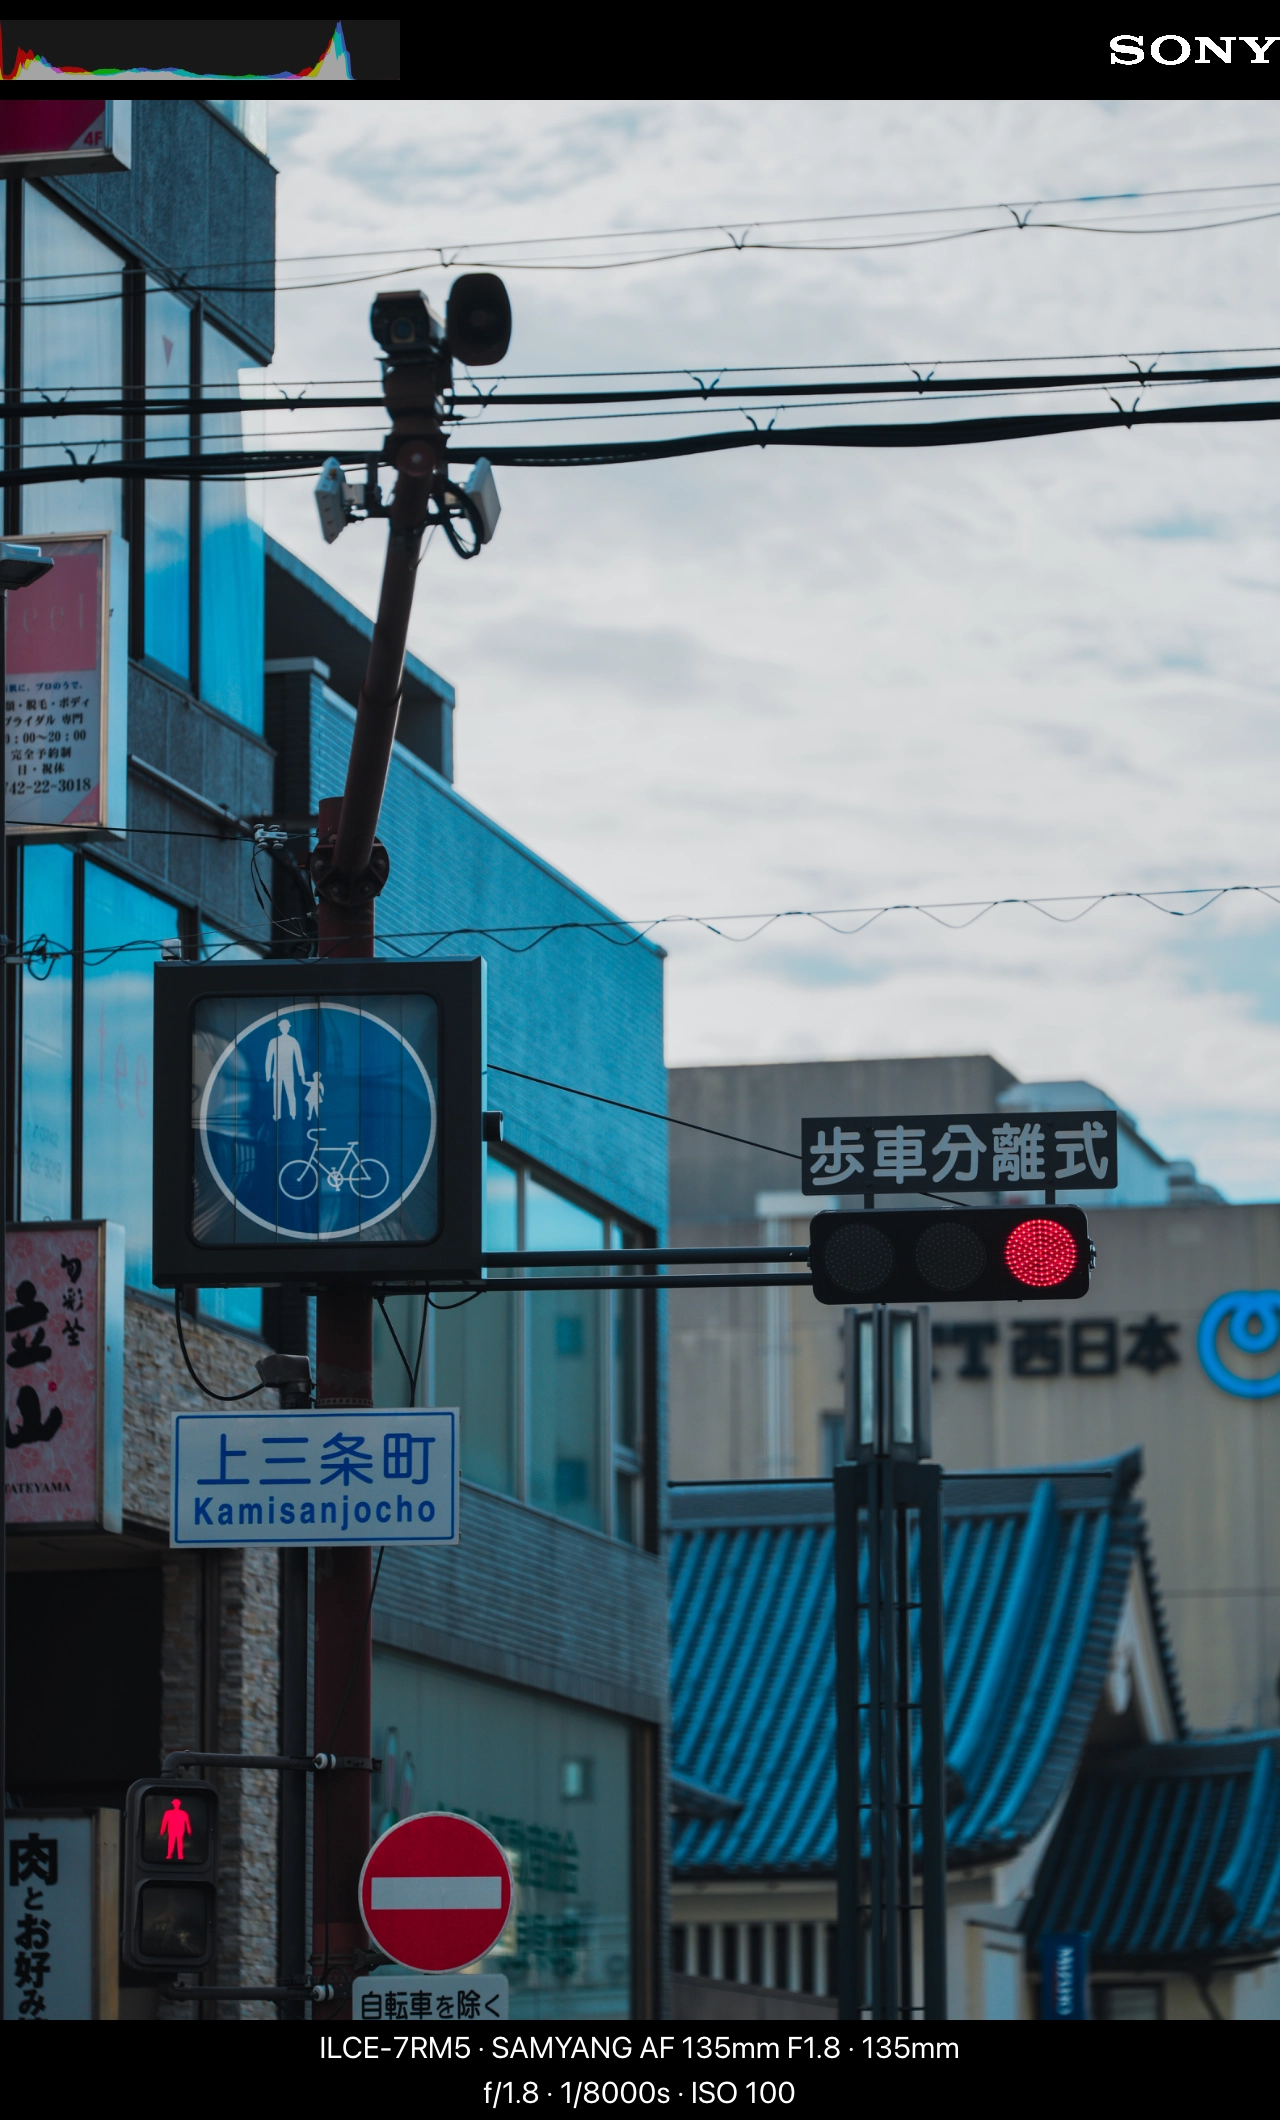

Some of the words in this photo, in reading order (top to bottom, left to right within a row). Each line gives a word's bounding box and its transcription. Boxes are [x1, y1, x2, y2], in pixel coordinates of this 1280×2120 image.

[83, 130, 103, 148] 4F
[8, 592, 86, 634] eel
[11, 747, 72, 761] 完全予約制
[809, 1120, 1109, 1187] 歩車分離式
[838, 1313, 1181, 1379] T西日本
[196, 1432, 436, 1487] 上三条町
[194, 1494, 436, 1532] Kamisanjocho
[9, 1832, 58, 2020] 肉とお好み
[361, 1989, 501, 2020] 自転車を除く
